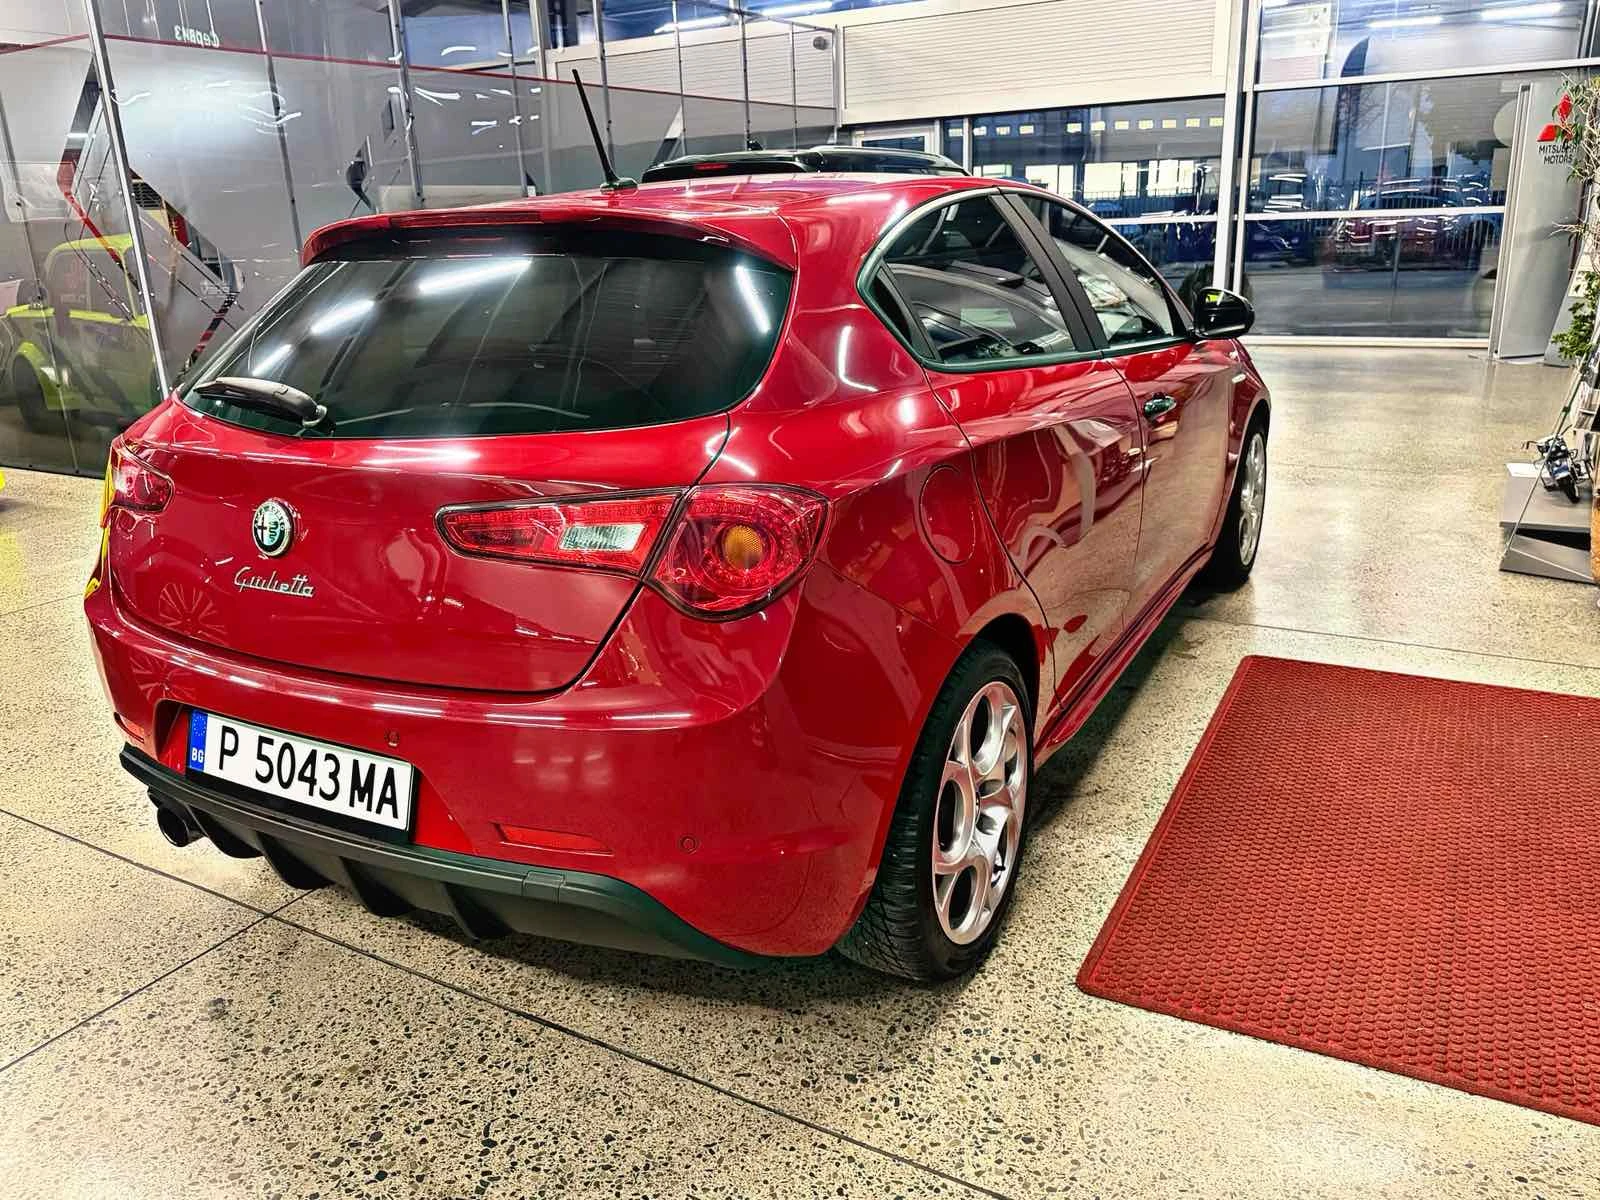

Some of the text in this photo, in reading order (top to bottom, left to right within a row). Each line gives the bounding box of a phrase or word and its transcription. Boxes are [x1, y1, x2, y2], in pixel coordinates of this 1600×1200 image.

[1543, 154, 1573, 164] MOTORS
[234, 566, 314, 598] Giulietta
[191, 750, 204, 763] BG
[219, 725, 399, 819] P 5043 MA
